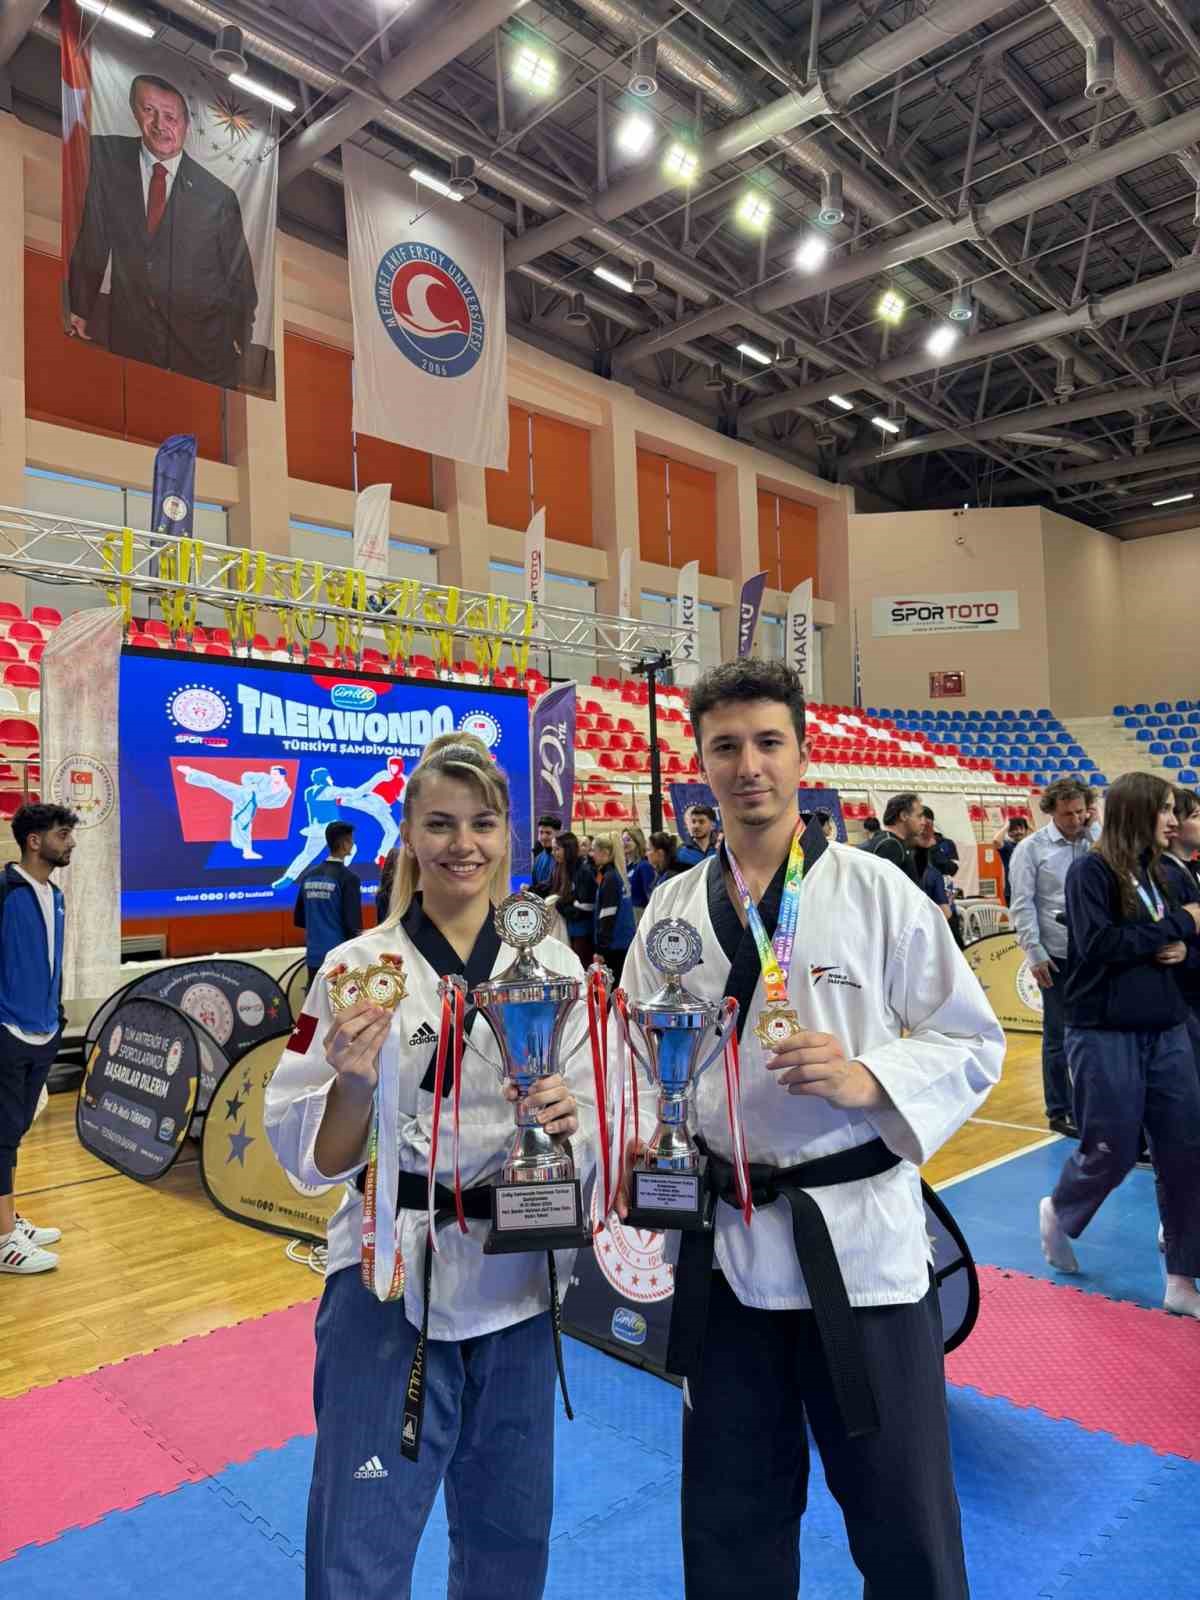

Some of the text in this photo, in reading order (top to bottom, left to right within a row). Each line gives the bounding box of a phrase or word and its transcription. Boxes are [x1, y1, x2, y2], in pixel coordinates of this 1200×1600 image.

[409, 245, 446, 266] ERSOY
[793, 614, 807, 674] MAKÜ
[237, 683, 454, 745] TAEKWONDO
[283, 739, 420, 758] TÜRKİYE ŞAMPİYONASI
[353, 1469, 389, 1480] adidas
